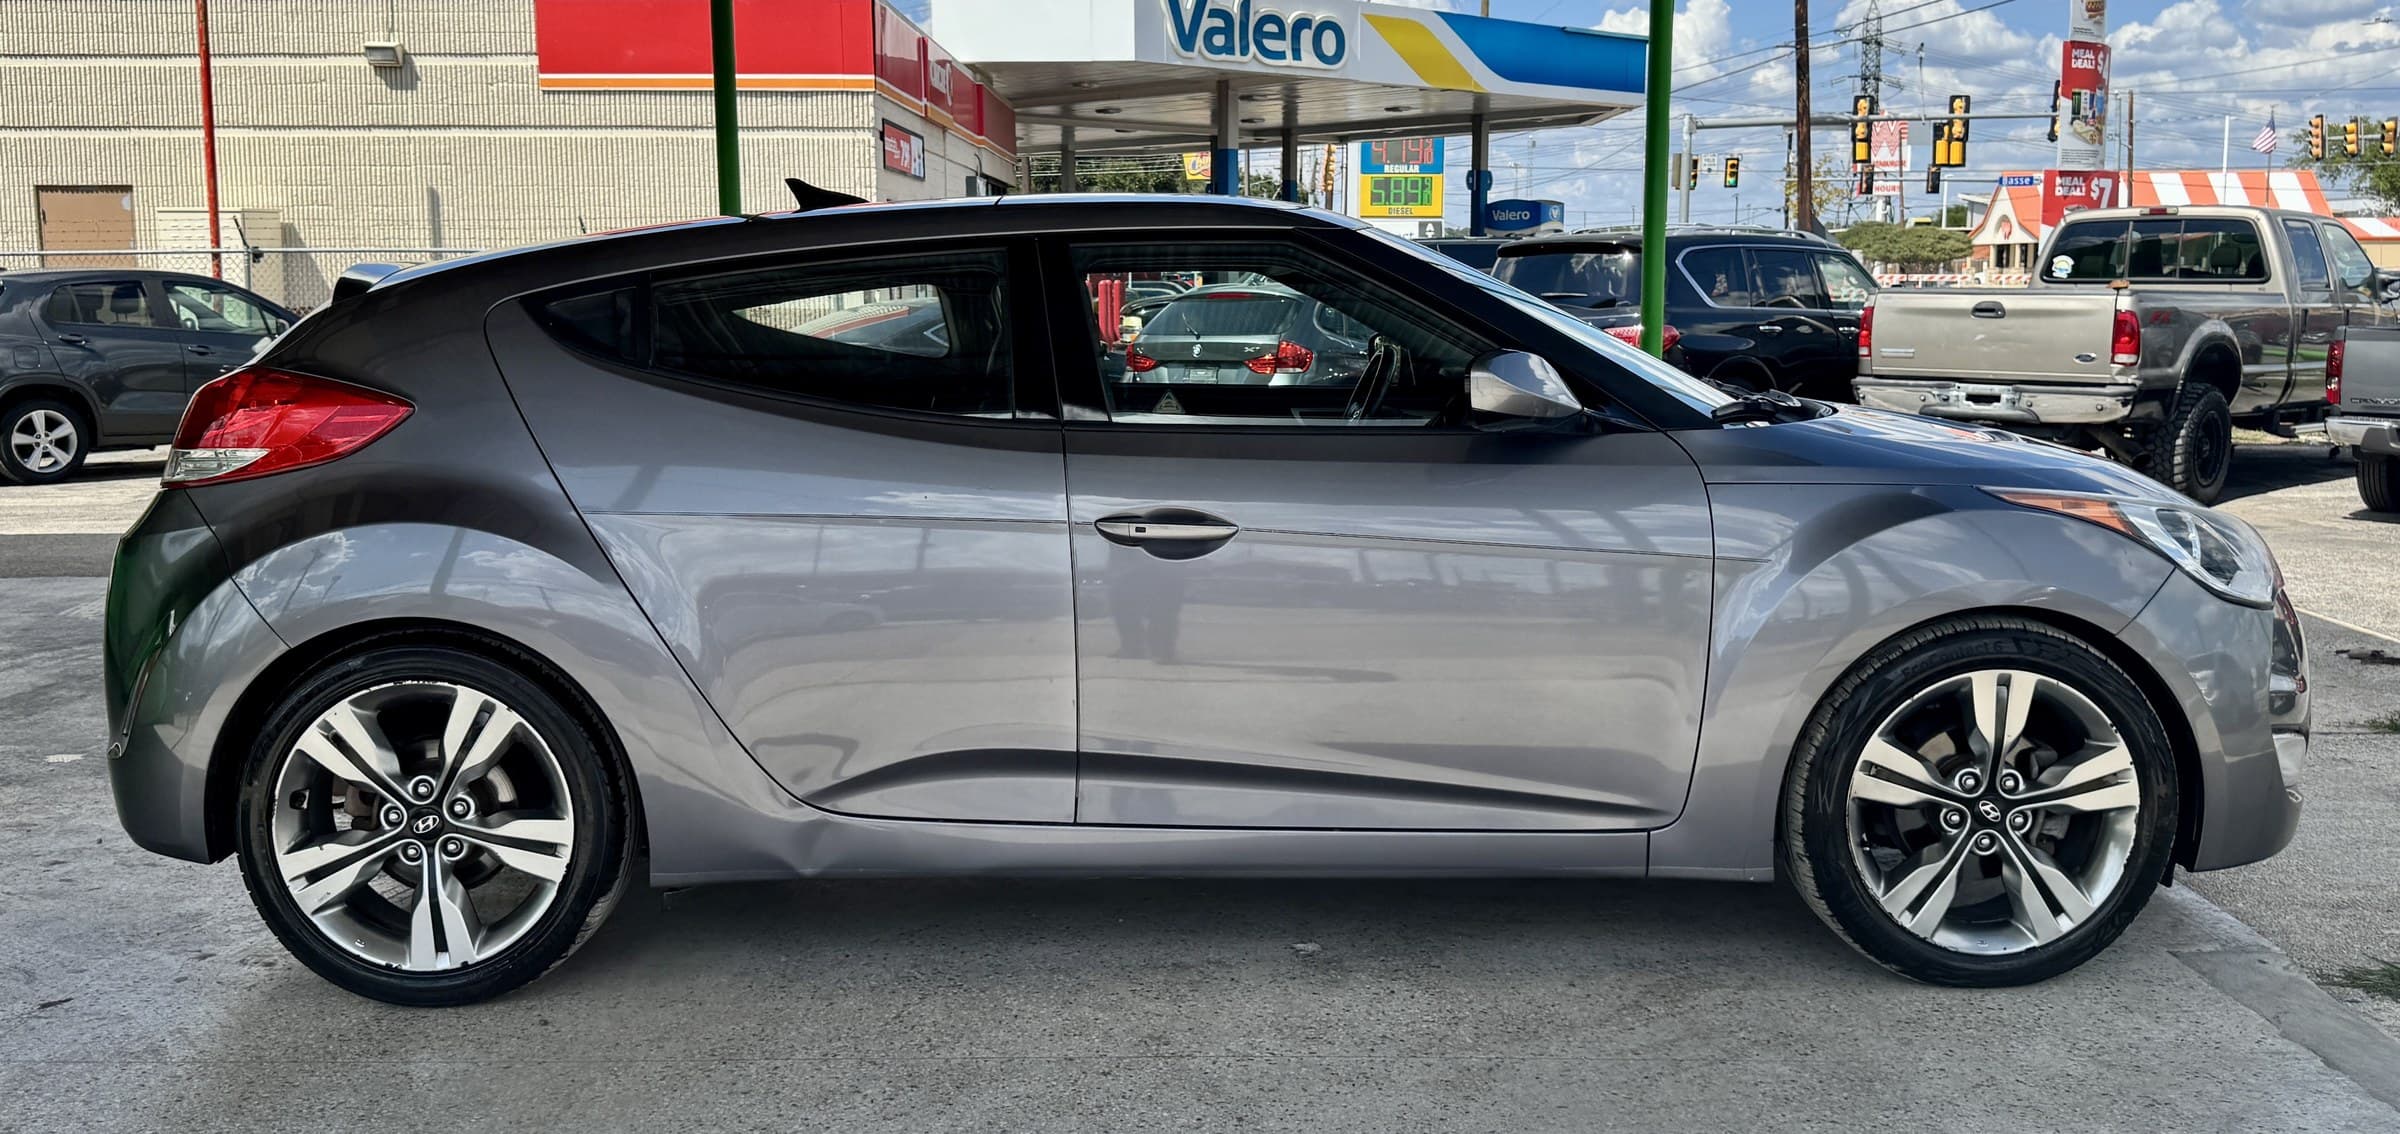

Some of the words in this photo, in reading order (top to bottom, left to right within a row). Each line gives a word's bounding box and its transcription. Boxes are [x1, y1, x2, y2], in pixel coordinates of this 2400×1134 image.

[1167, 0, 1346, 66] Valero
[2071, 48, 2095, 59] MEAL
[1384, 164, 1420, 173] REGULAR
[2055, 176, 2084, 186] MEAL
[1371, 177, 1421, 205] 5.89
[2055, 185, 2086, 196] DEAL!
[2090, 176, 2113, 208] $7
[1388, 207, 1414, 215] DIESEL
[1492, 209, 1531, 221] Valero
